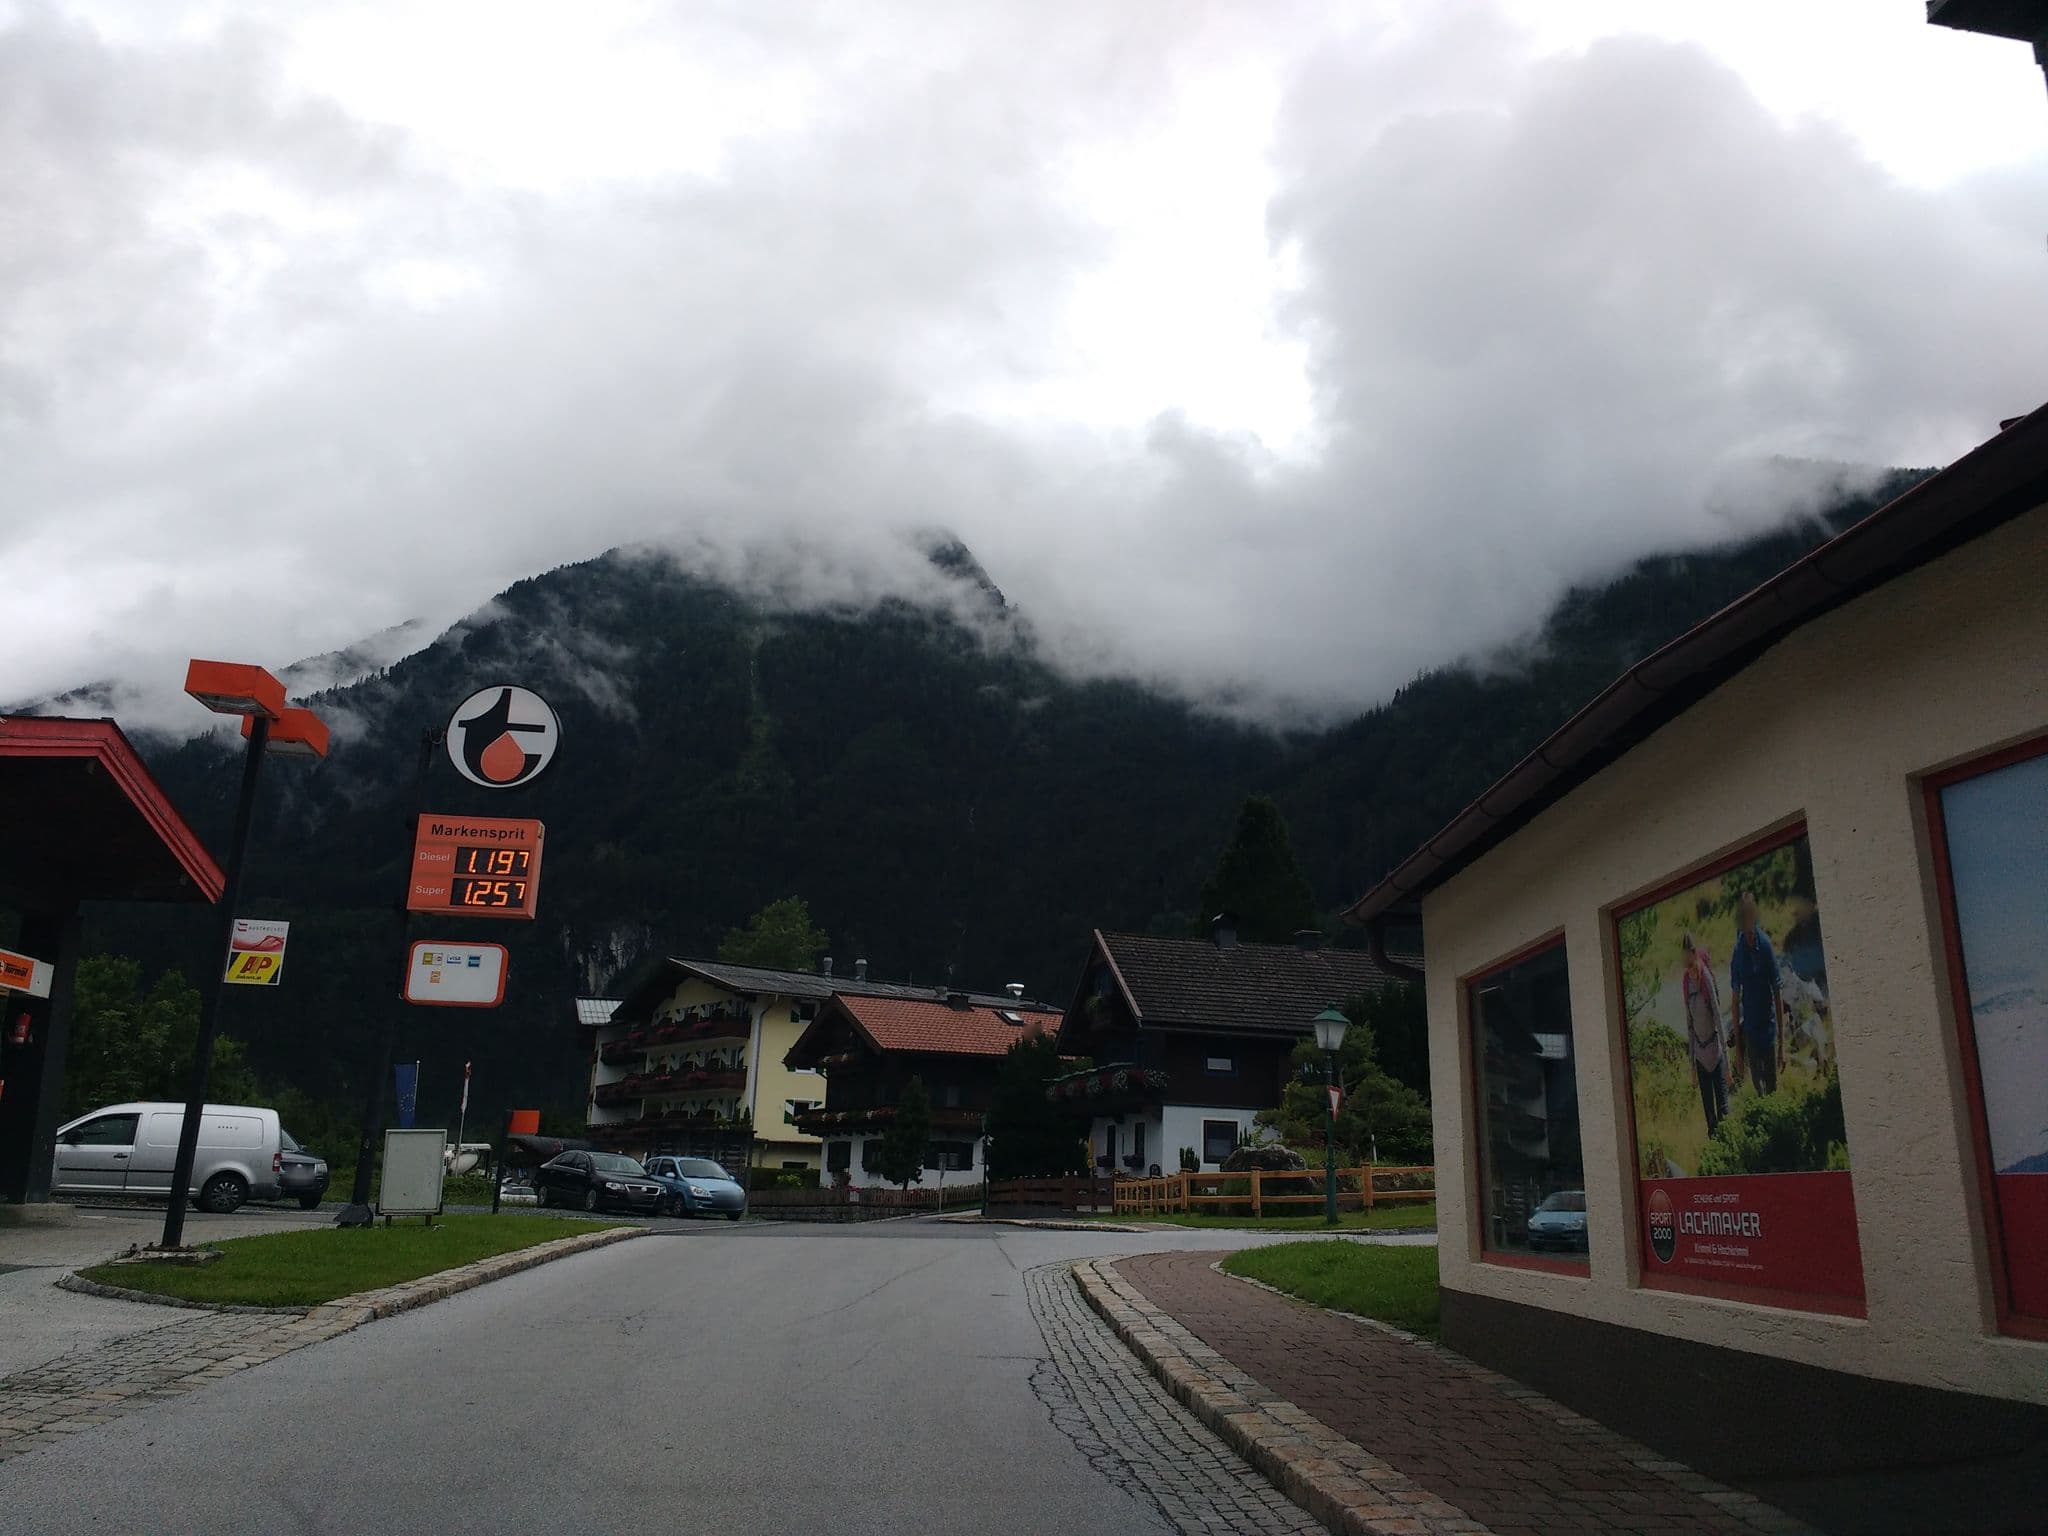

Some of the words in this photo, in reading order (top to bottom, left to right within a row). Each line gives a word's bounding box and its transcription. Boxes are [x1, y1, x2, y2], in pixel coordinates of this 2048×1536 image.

[431, 824, 525, 841] Markensprit
[420, 852, 450, 862] Diesel
[415, 886, 445, 895] Super
[1651, 1213, 1672, 1225] SPORT
[1679, 1211, 1762, 1237] LACHMAYER
[1653, 1227, 1672, 1240] 2000
